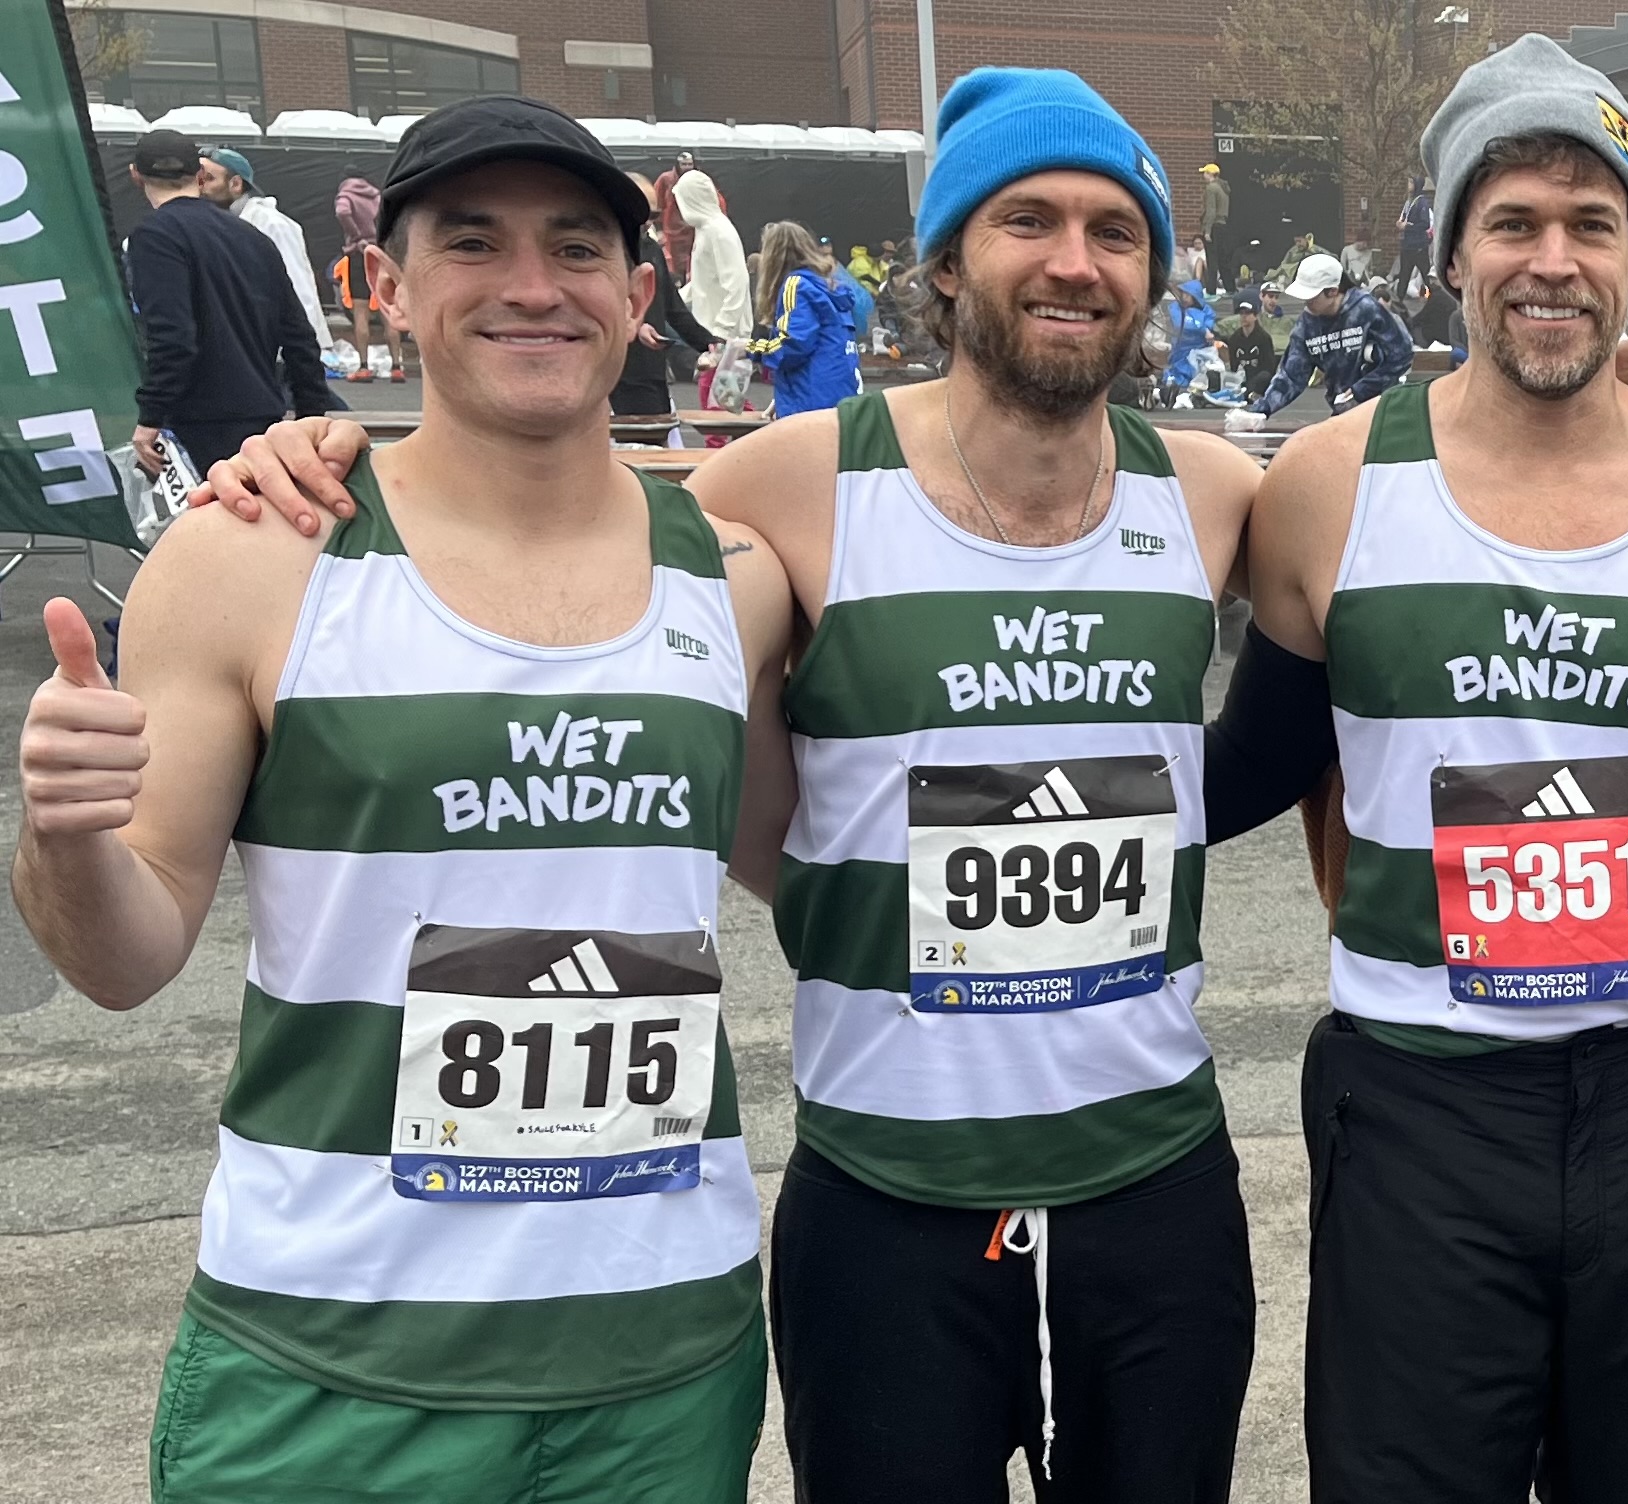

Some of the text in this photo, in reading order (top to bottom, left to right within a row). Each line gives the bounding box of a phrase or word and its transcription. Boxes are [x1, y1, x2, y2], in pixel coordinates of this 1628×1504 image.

[1118, 528, 1166, 550] Ultras
[992, 605, 1104, 655] WET
[1503, 604, 1615, 656] WET
[662, 627, 709, 656] Ultras
[937, 660, 1156, 712] BANDITS
[507, 711, 643, 768] WET
[432, 775, 690, 833] BANDITS
[945, 837, 1147, 930] 9394
[925, 946, 938, 961] 2
[1453, 940, 1464, 954] 6
[1009, 977, 1071, 993] BOSTON
[1526, 972, 1586, 986] BOSTON
[971, 991, 1072, 1006] MARATHON
[1494, 985, 1587, 999] MARATHON
[438, 1018, 681, 1109] 8115
[411, 1124, 421, 1140] 1
[504, 1166, 579, 1179] BOSTON
[459, 1179, 580, 1193] MARATHON
